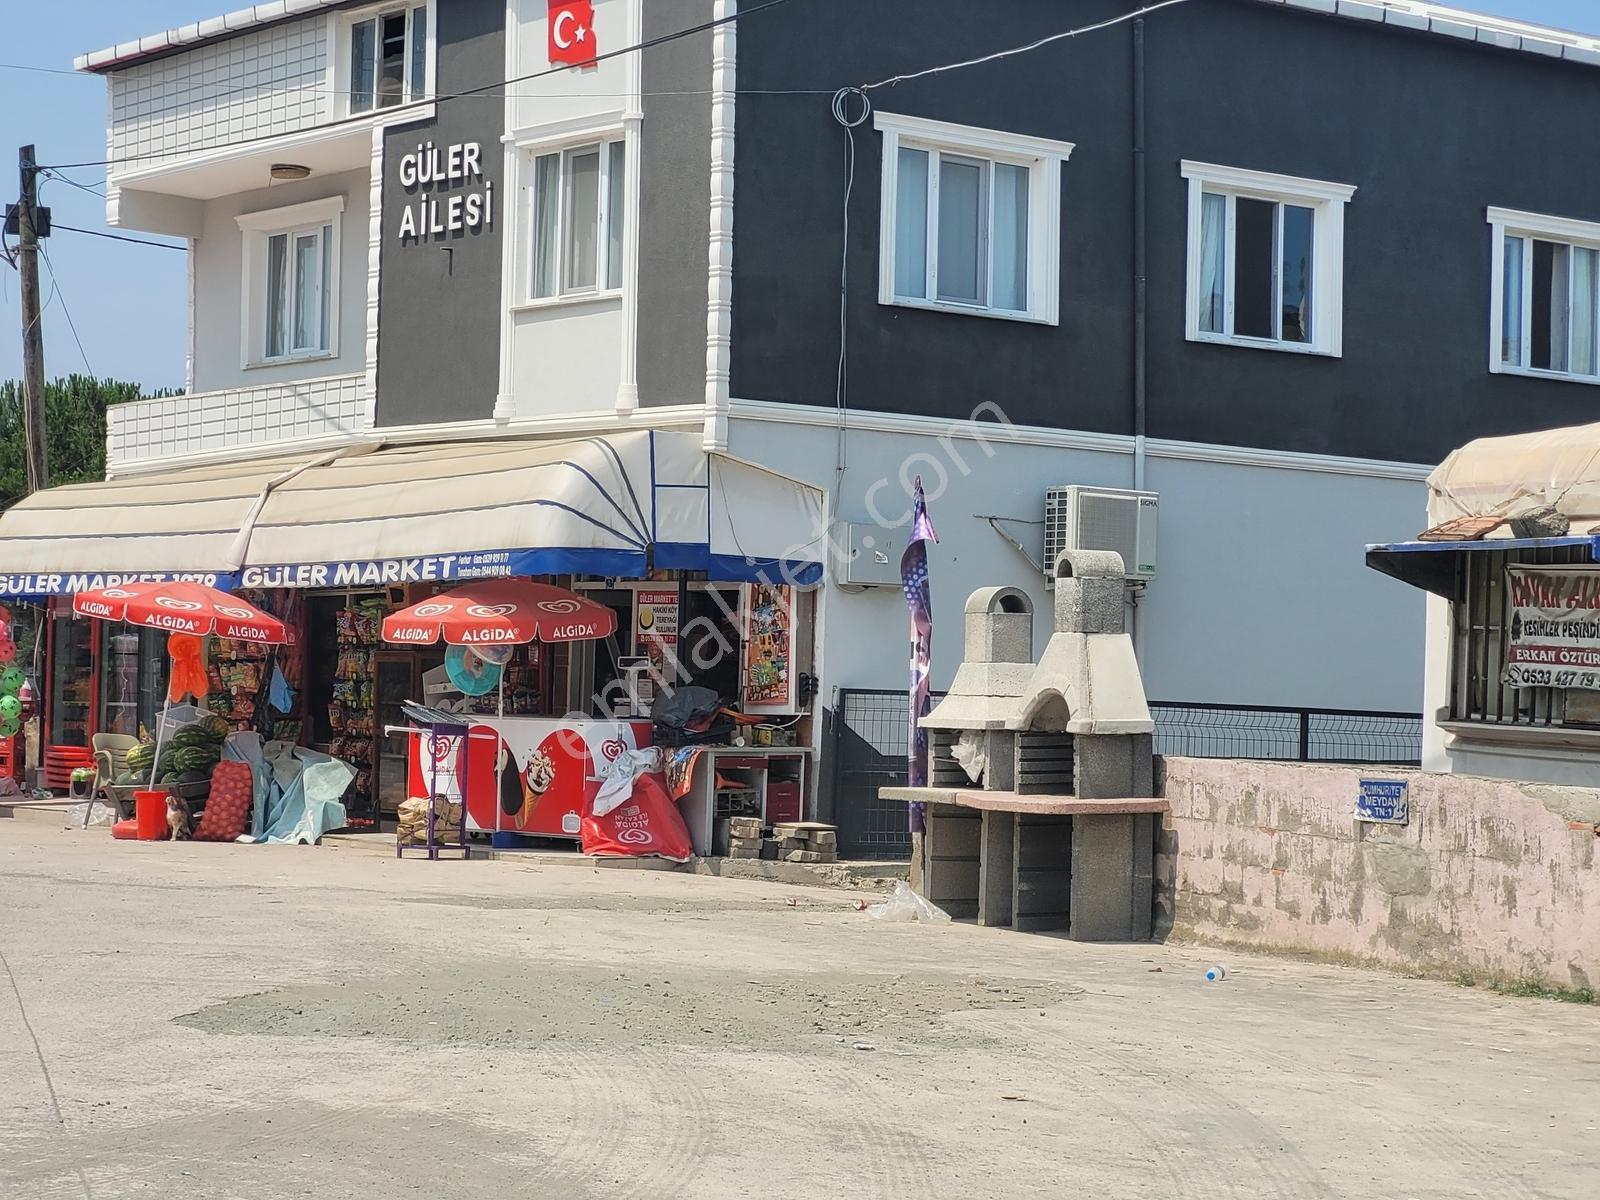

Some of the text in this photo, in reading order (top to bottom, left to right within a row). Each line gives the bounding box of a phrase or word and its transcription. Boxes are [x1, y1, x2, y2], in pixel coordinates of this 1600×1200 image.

[400, 141, 480, 187] GÜLER
[398, 181, 492, 238] AİLESİ
[242, 556, 456, 587] GÜLER MARKET
[1516, 649, 1555, 662] ERKAN
[1521, 669, 1551, 685] 0533
